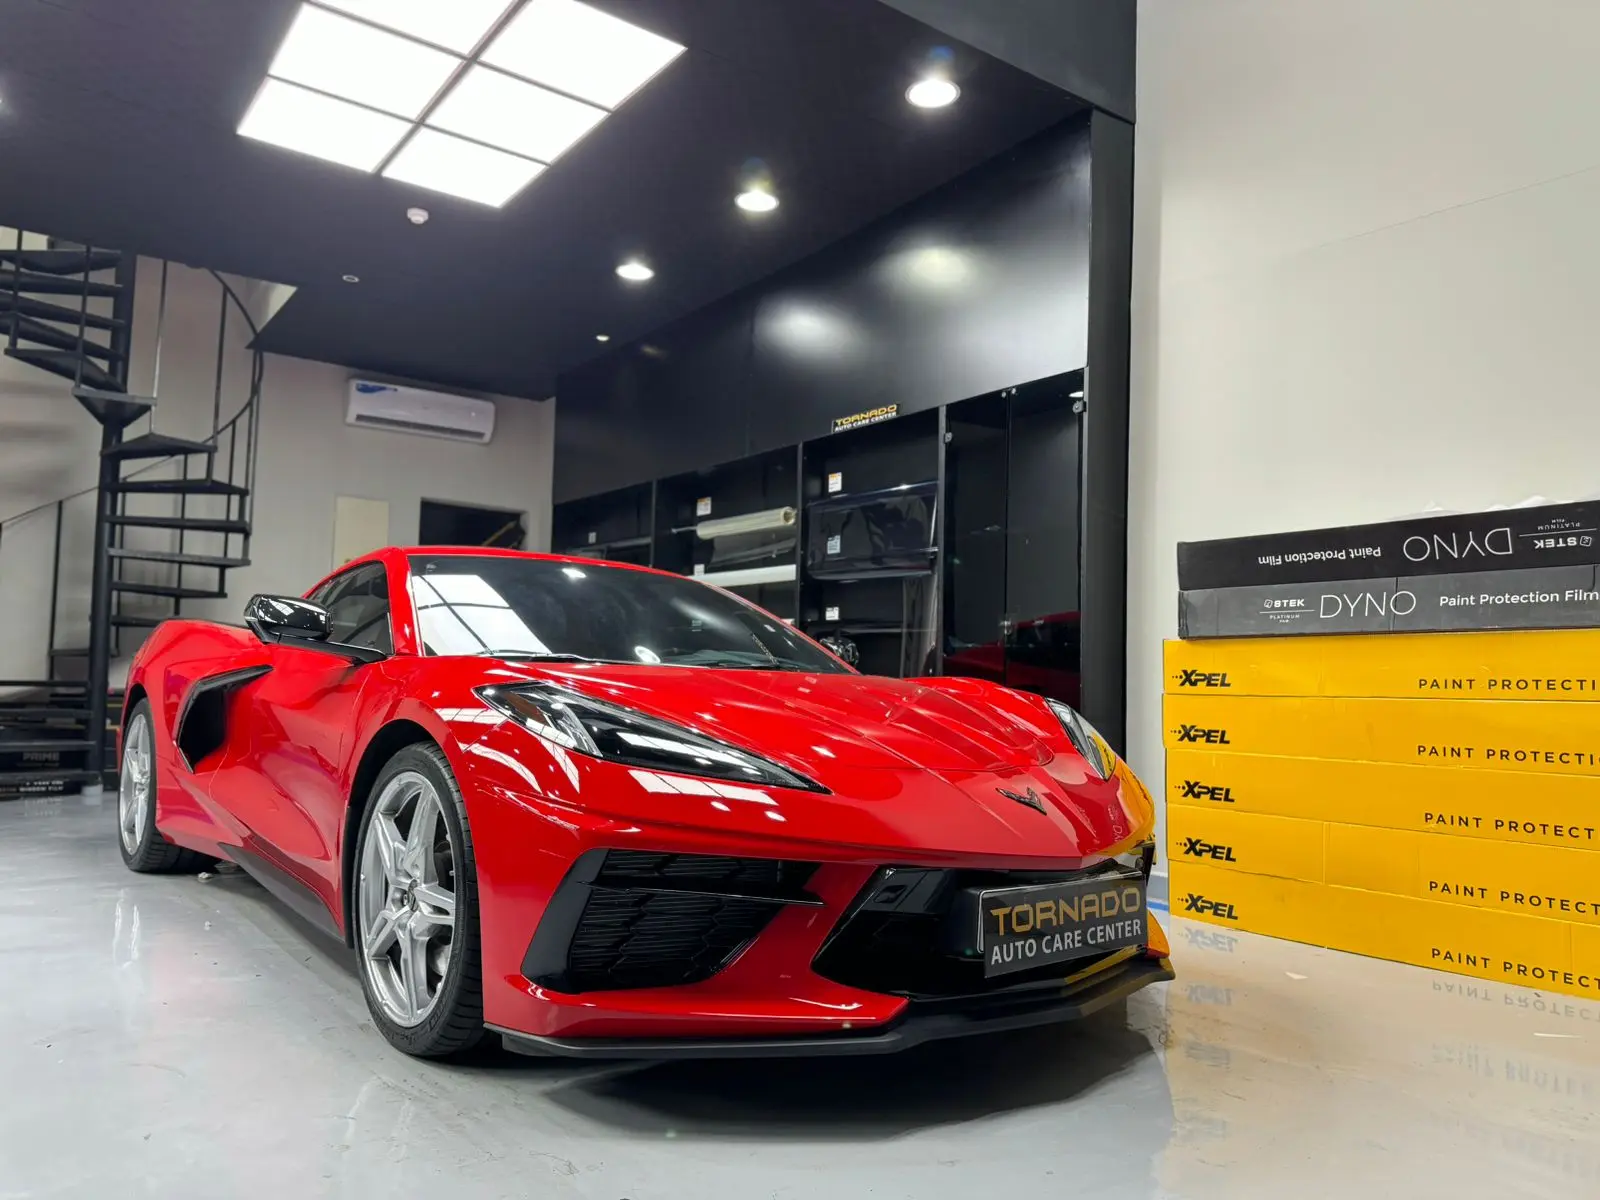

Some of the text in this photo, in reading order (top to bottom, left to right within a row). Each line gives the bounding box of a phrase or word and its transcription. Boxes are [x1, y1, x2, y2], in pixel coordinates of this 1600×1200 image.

[836, 404, 897, 426] TORNADO
[834, 423, 852, 432] AUTO
[1537, 522, 1581, 531] PLATINUM
[1403, 527, 1513, 562] DYNO
[1533, 536, 1577, 549] STEK
[1258, 547, 1382, 566] Paint Protection Film
[1320, 591, 1417, 618] DYNO
[1440, 589, 1600, 607] Paint Protection Film
[1178, 669, 1231, 687] XPEL
[1418, 679, 1596, 691] PAINT PROTECTI
[1177, 724, 1230, 744] XPEL
[1417, 745, 1600, 766] PAINT PROTECTI
[1181, 780, 1235, 803] XPEL
[1424, 812, 1595, 840] PAINT PROTECT
[1184, 837, 1237, 862] XPEL
[1185, 893, 1238, 920] XPEL
[1429, 881, 1600, 916] PAINT PROTECT
[990, 887, 1141, 936] TORNADO
[991, 919, 1142, 965] AUTO CARE CENTER
[1431, 948, 1491, 969] PAINT
